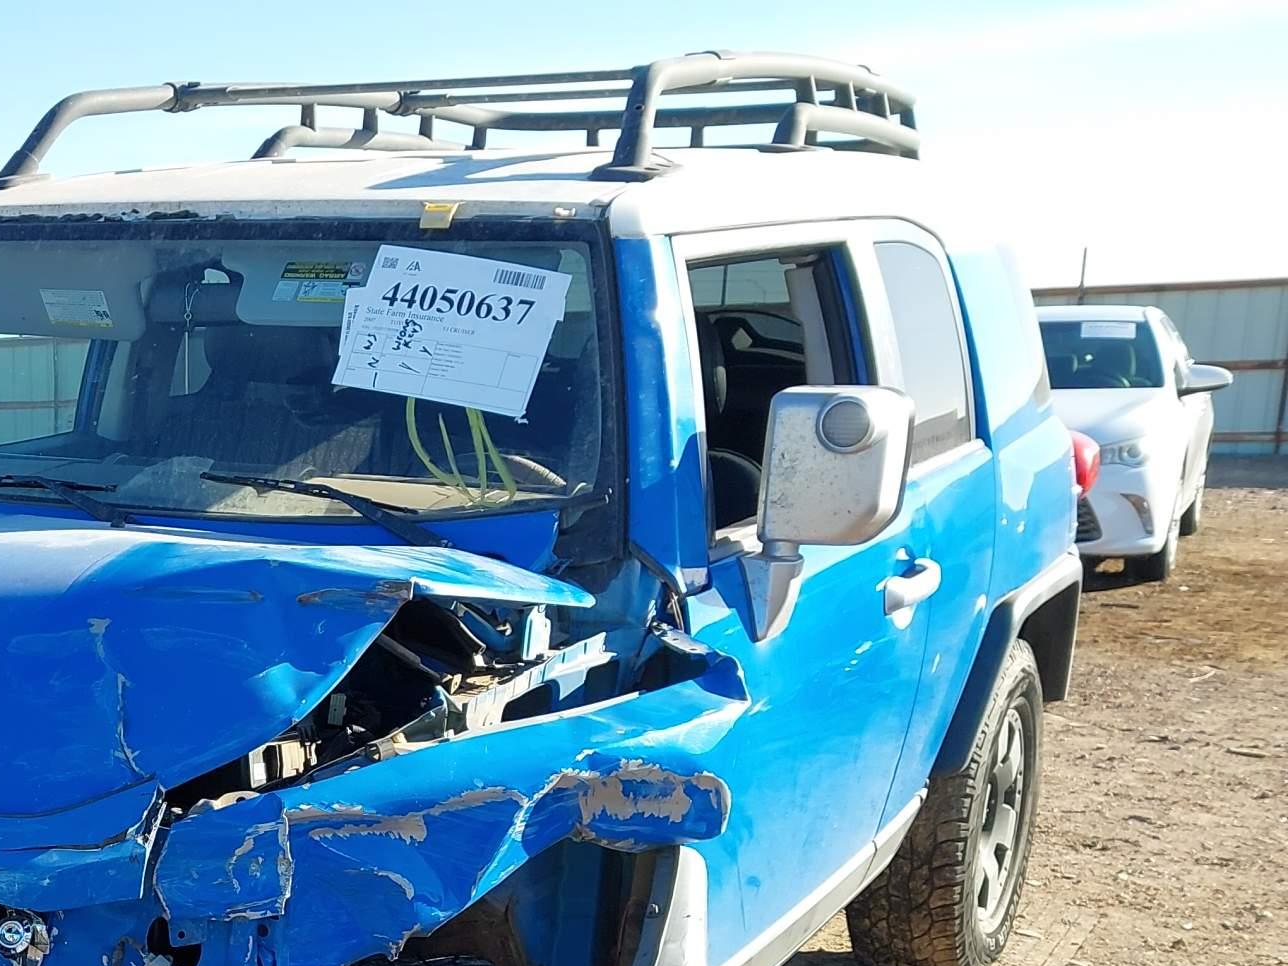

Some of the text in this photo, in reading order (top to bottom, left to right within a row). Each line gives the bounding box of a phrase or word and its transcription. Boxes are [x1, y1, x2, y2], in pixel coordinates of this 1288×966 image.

[366, 305, 445, 323] State Farm Insurance
[382, 281, 536, 325] 44050637
